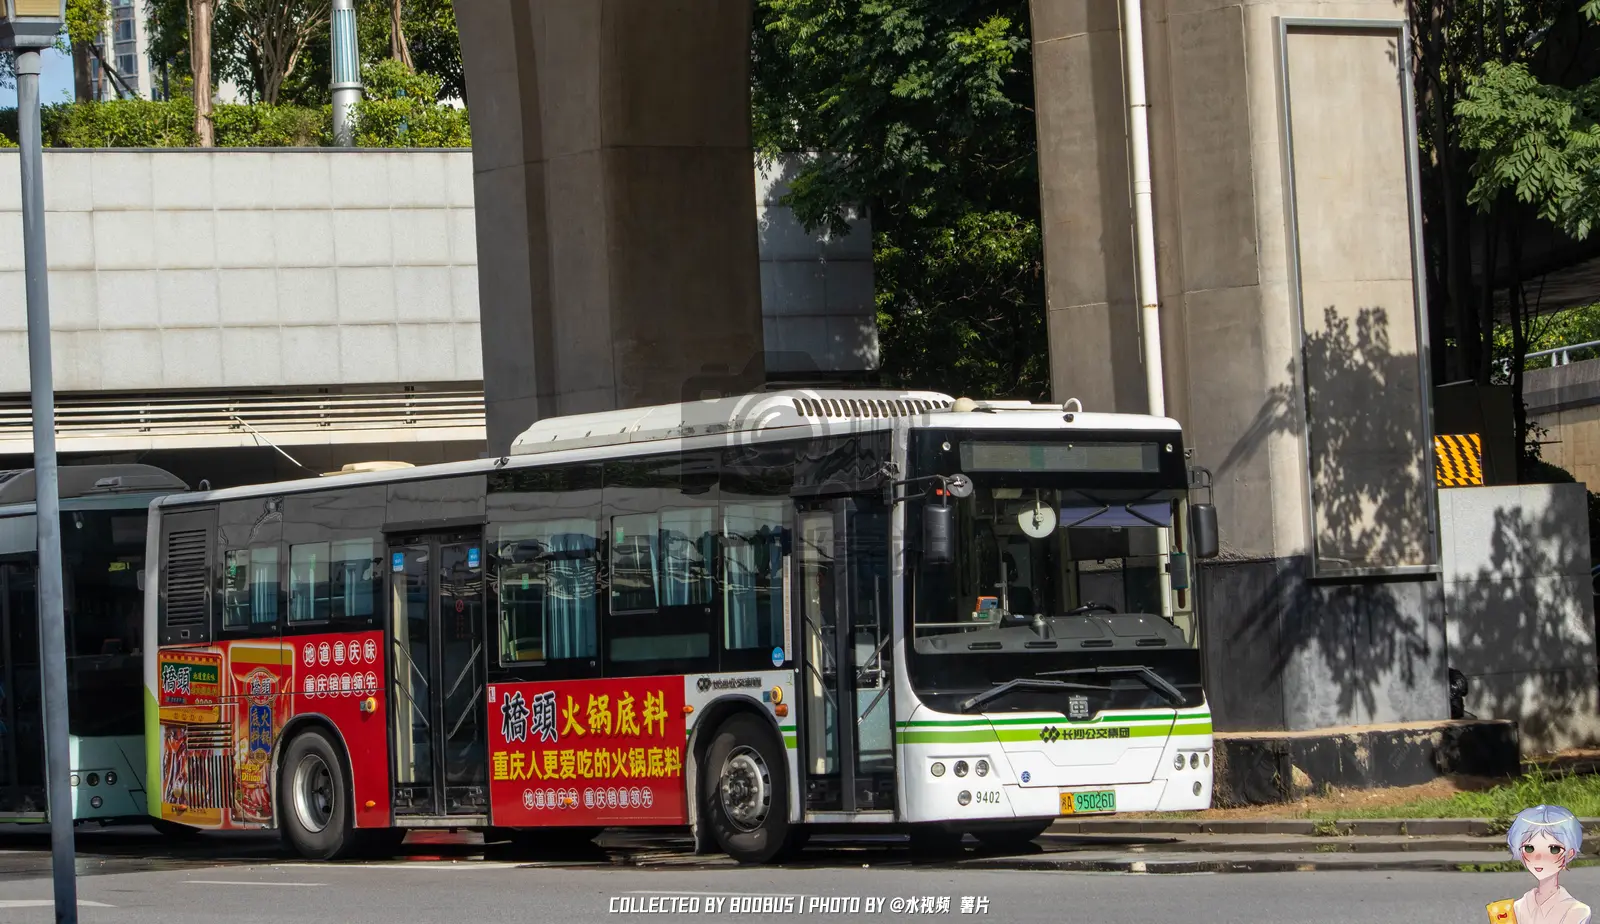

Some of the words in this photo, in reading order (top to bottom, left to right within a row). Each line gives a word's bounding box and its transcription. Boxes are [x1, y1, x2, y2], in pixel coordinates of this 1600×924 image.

[304, 640, 376, 665] 地道重庆味
[162, 665, 191, 696] 橋頭
[304, 673, 377, 697] 重庆销量领先
[1062, 728, 1130, 740] 长沙公交集团
[493, 747, 682, 781] 重庆人更爱吃的火锅底料
[584, 787, 653, 809] 重庆销量领先
[976, 792, 1000, 804] 9402
